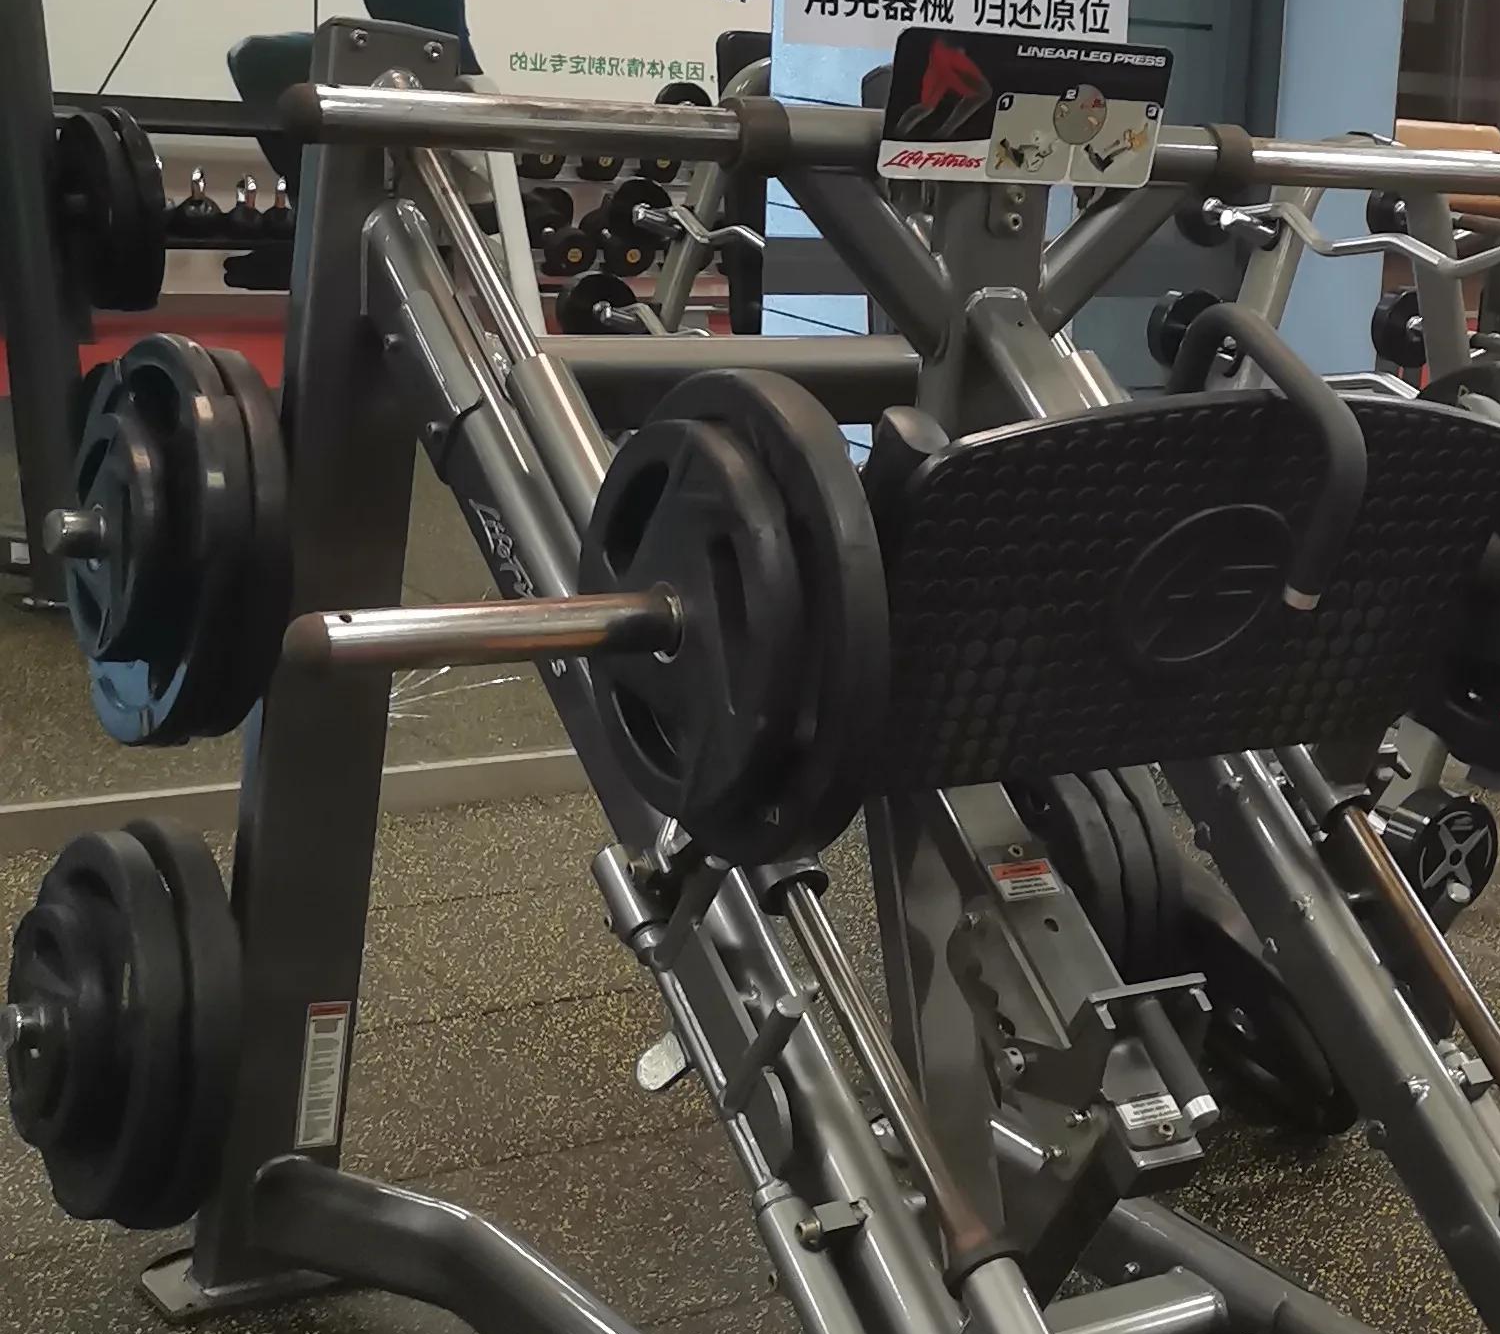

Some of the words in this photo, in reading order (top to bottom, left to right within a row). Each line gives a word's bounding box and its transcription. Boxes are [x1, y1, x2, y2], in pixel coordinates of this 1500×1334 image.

[1017, 45, 1079, 61] LINEAR
[1079, 48, 1112, 63] LEG
[1112, 51, 1167, 68] PRESS
